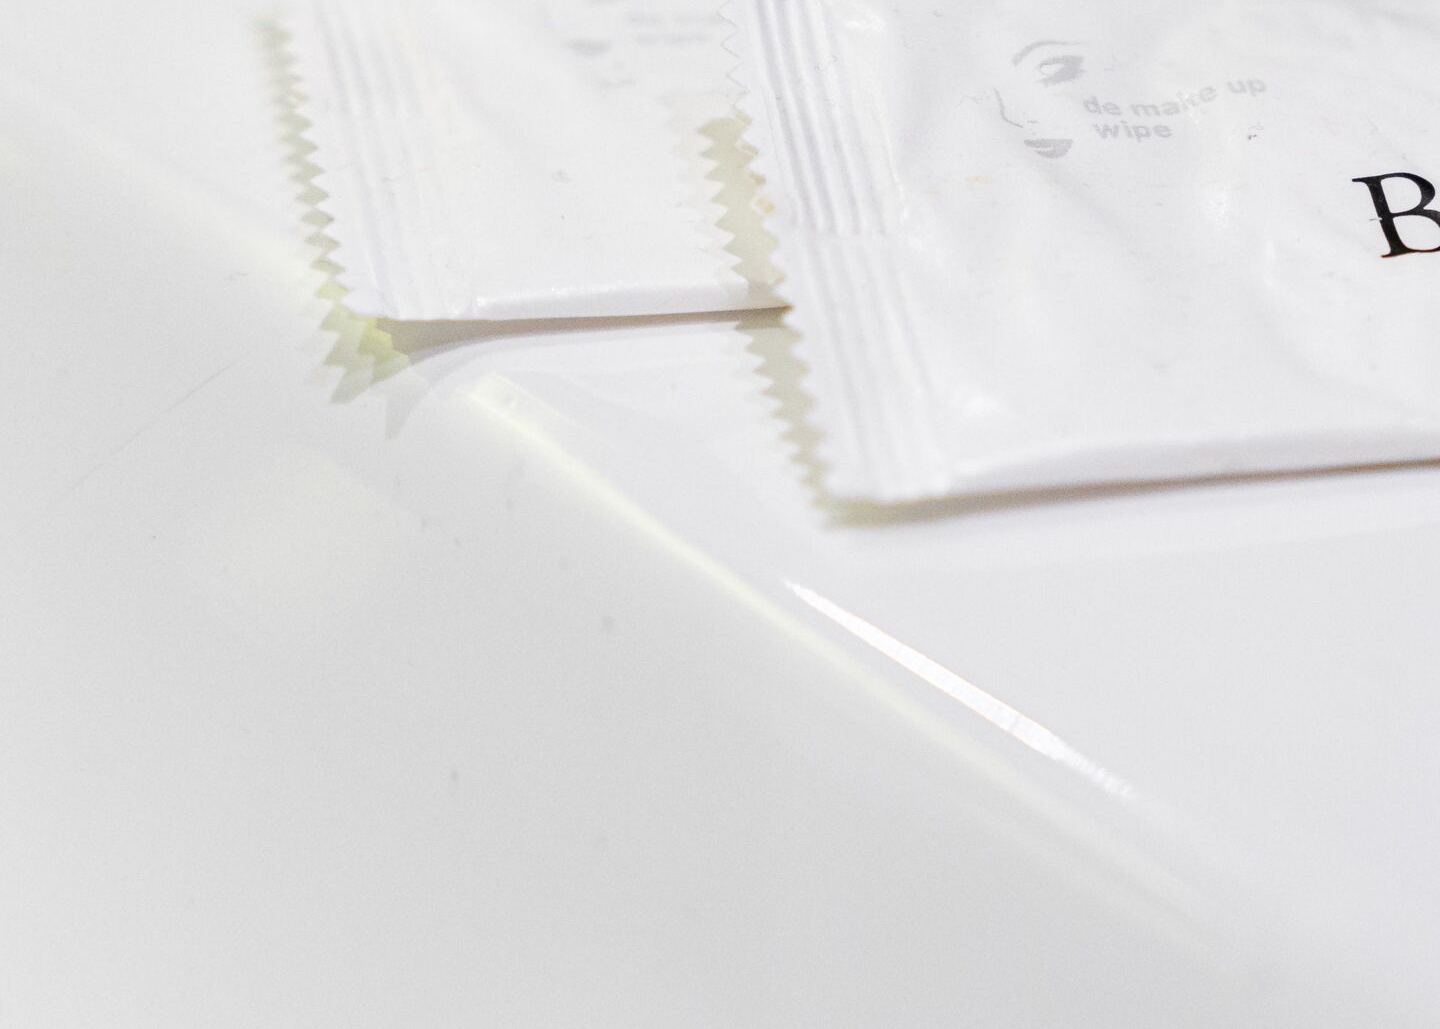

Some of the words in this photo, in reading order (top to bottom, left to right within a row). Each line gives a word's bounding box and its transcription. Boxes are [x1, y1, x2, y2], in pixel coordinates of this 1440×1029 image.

[1082, 96, 1122, 115] de
[1226, 78, 1266, 96] up
[1092, 120, 1173, 143] wipe
